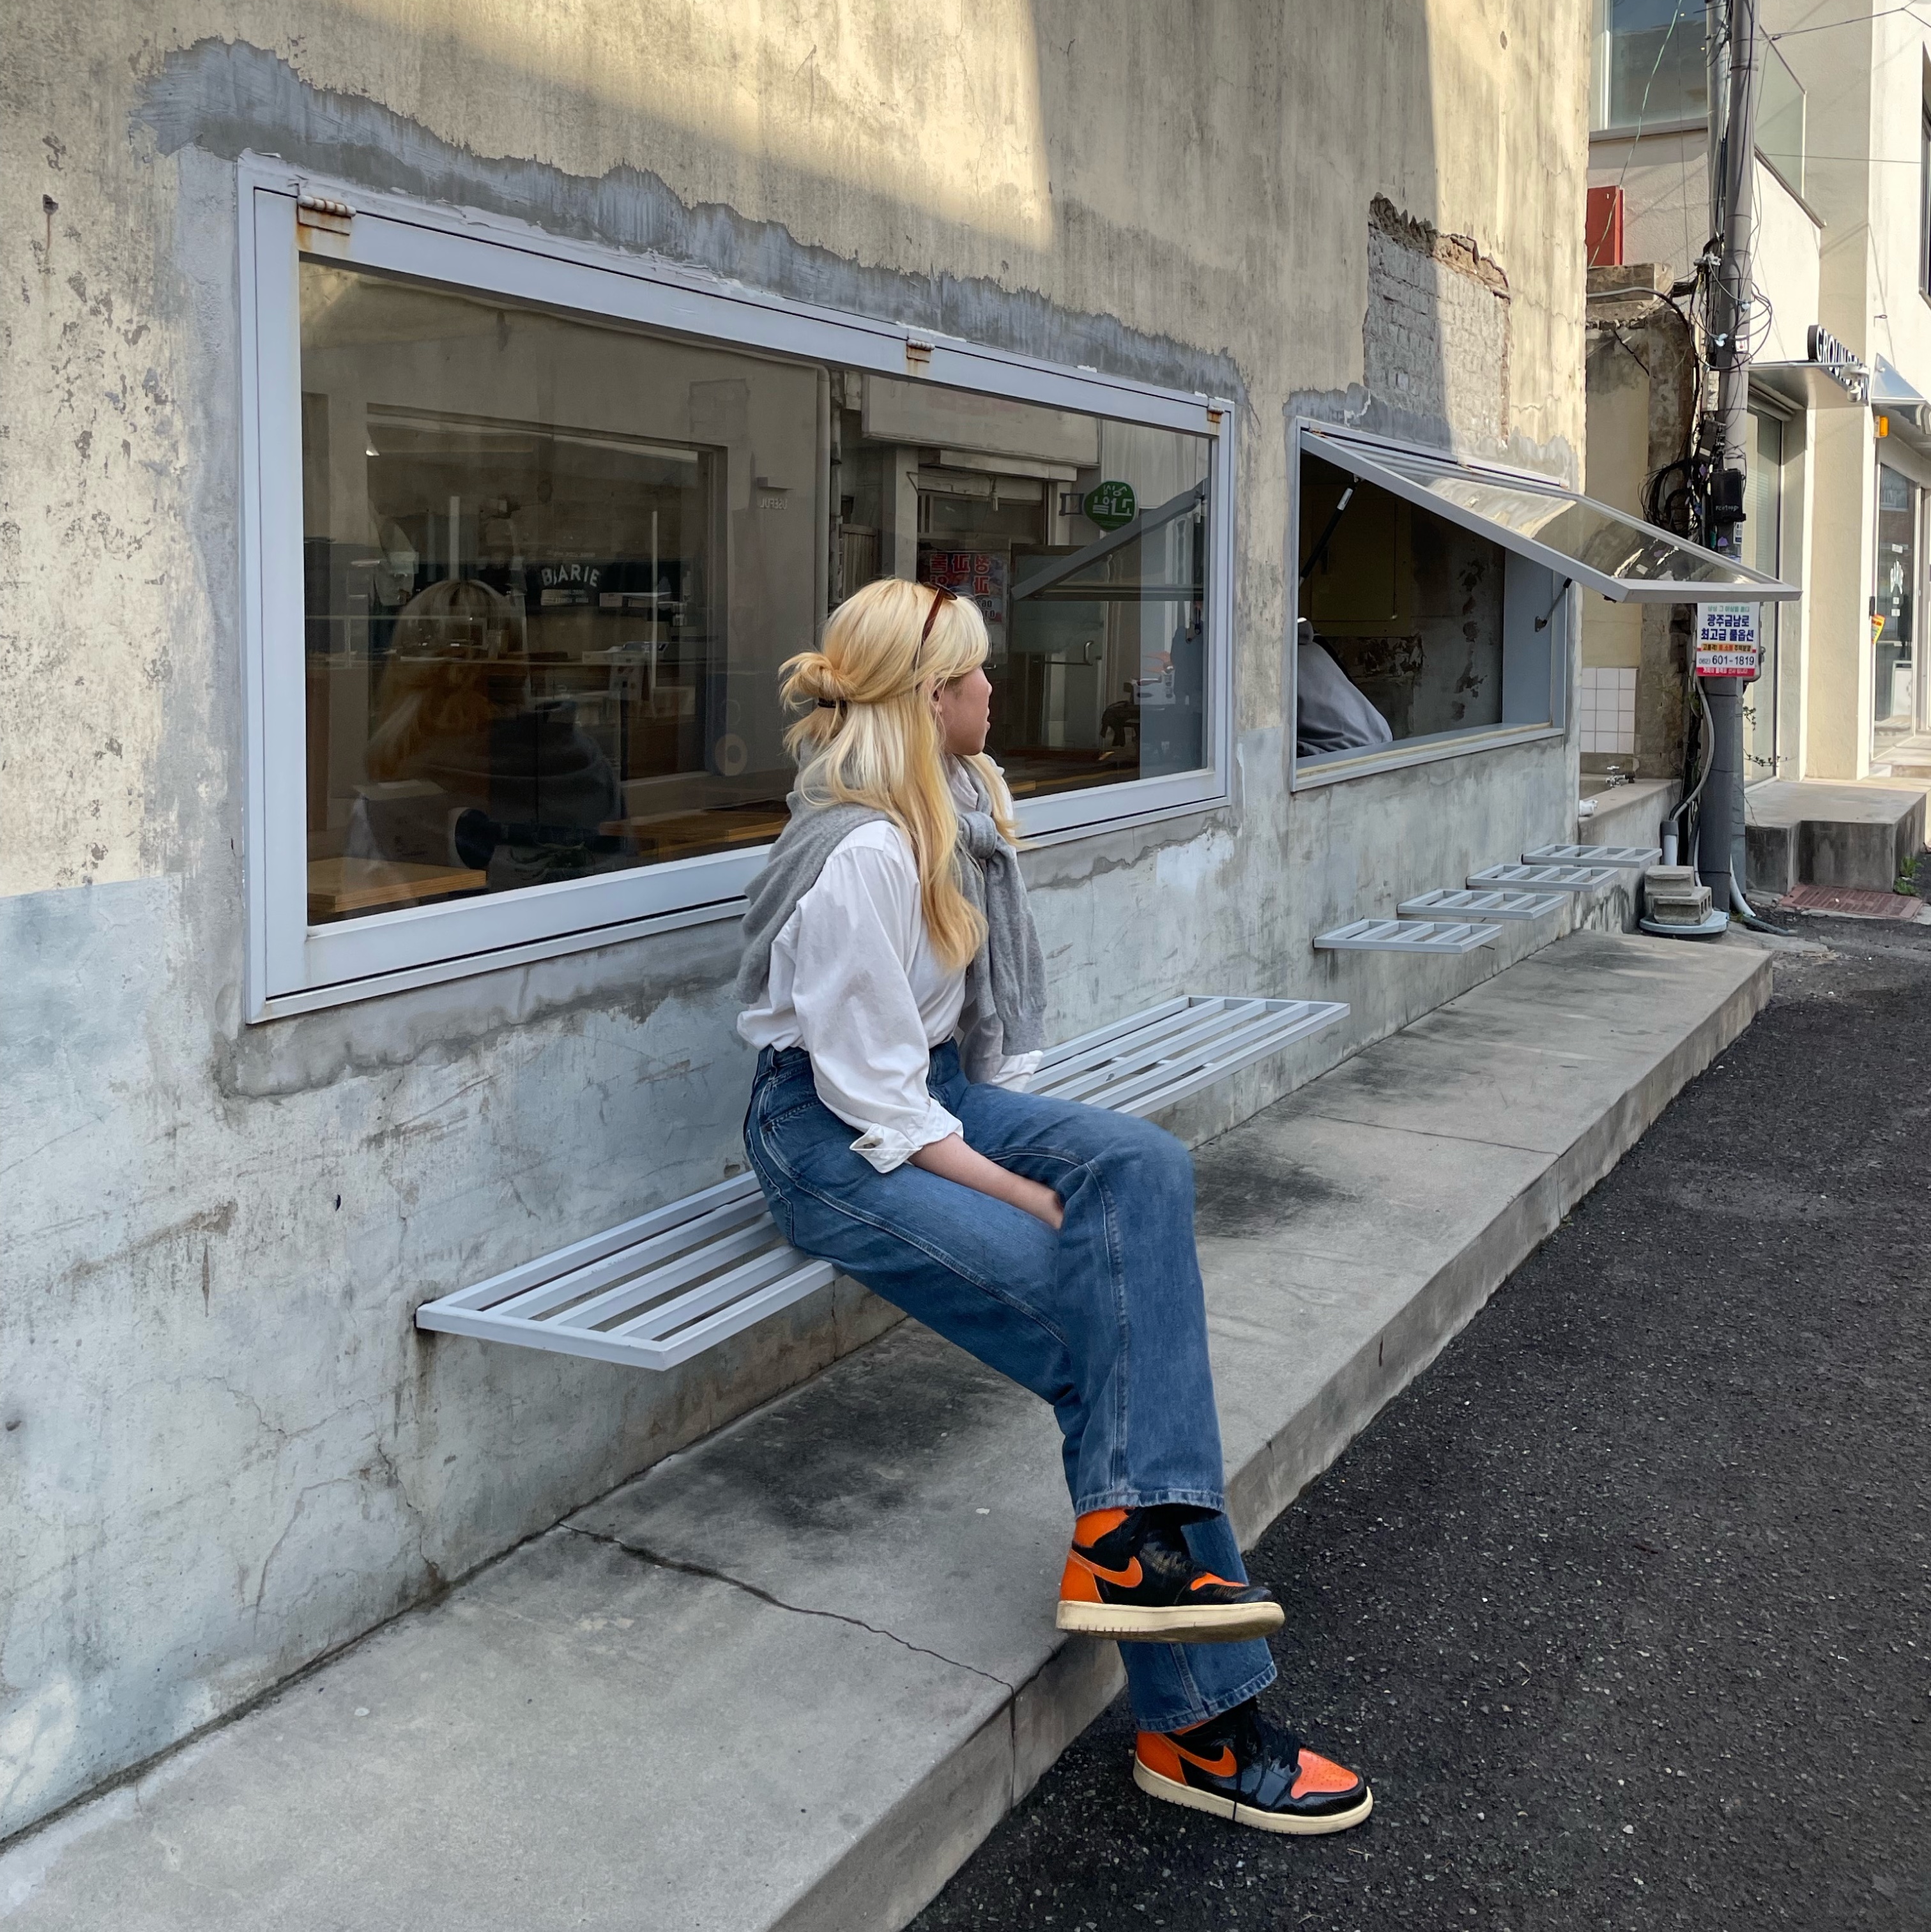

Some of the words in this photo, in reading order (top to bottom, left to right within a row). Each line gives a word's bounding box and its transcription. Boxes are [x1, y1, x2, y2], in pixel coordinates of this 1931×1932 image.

[1707, 614, 1750, 627] 광주금남로
[1701, 628, 1727, 641] 최고급
[1730, 629, 1754, 642] 풀옵션
[1713, 655, 1755, 666] 601-1819
